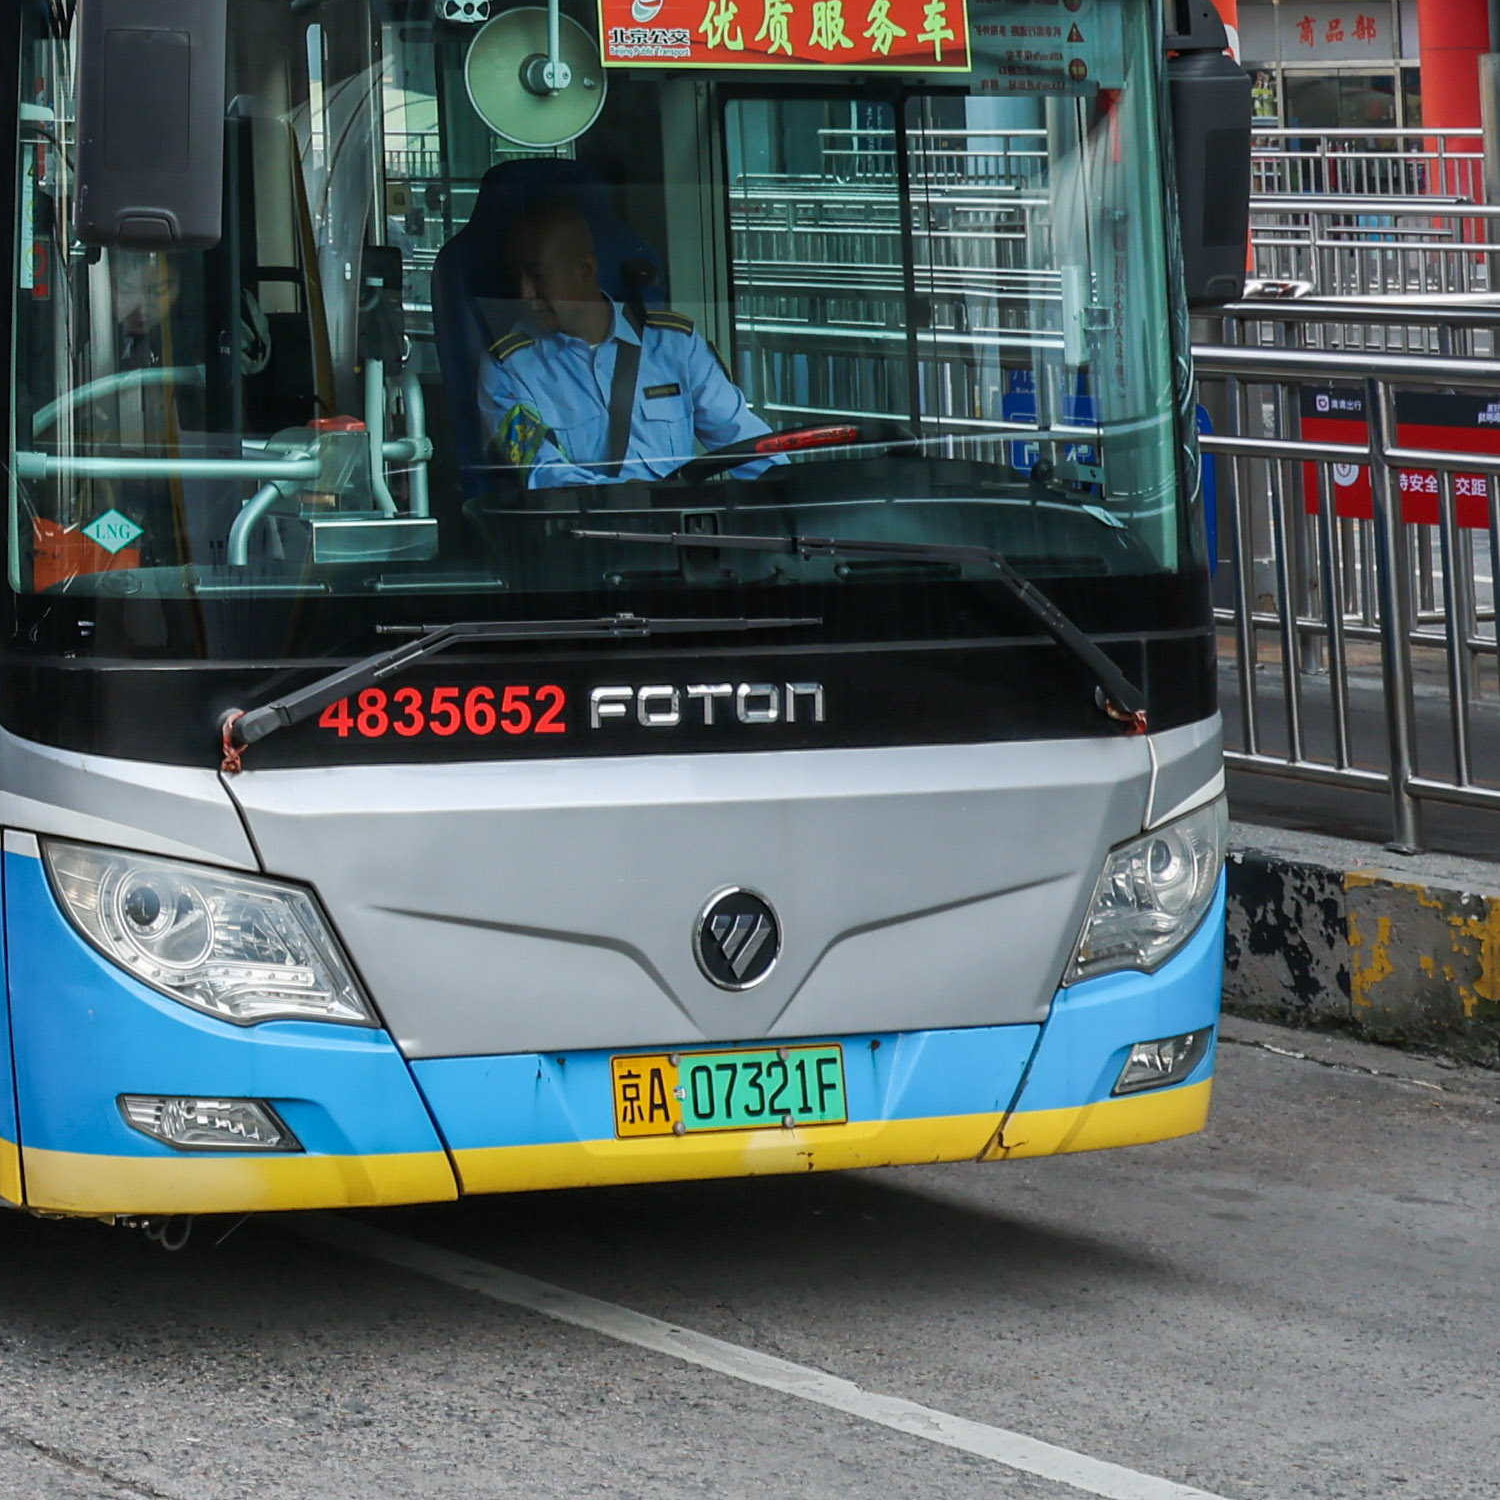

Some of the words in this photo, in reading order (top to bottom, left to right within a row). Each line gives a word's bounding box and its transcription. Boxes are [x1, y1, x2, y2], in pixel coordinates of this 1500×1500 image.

[608, 27, 691, 45] 北京公交
[1296, 14, 1377, 48] 商品部
[95, 523, 130, 539] LNG
[318, 684, 567, 738] 4835652
[590, 681, 827, 729] FOTON
